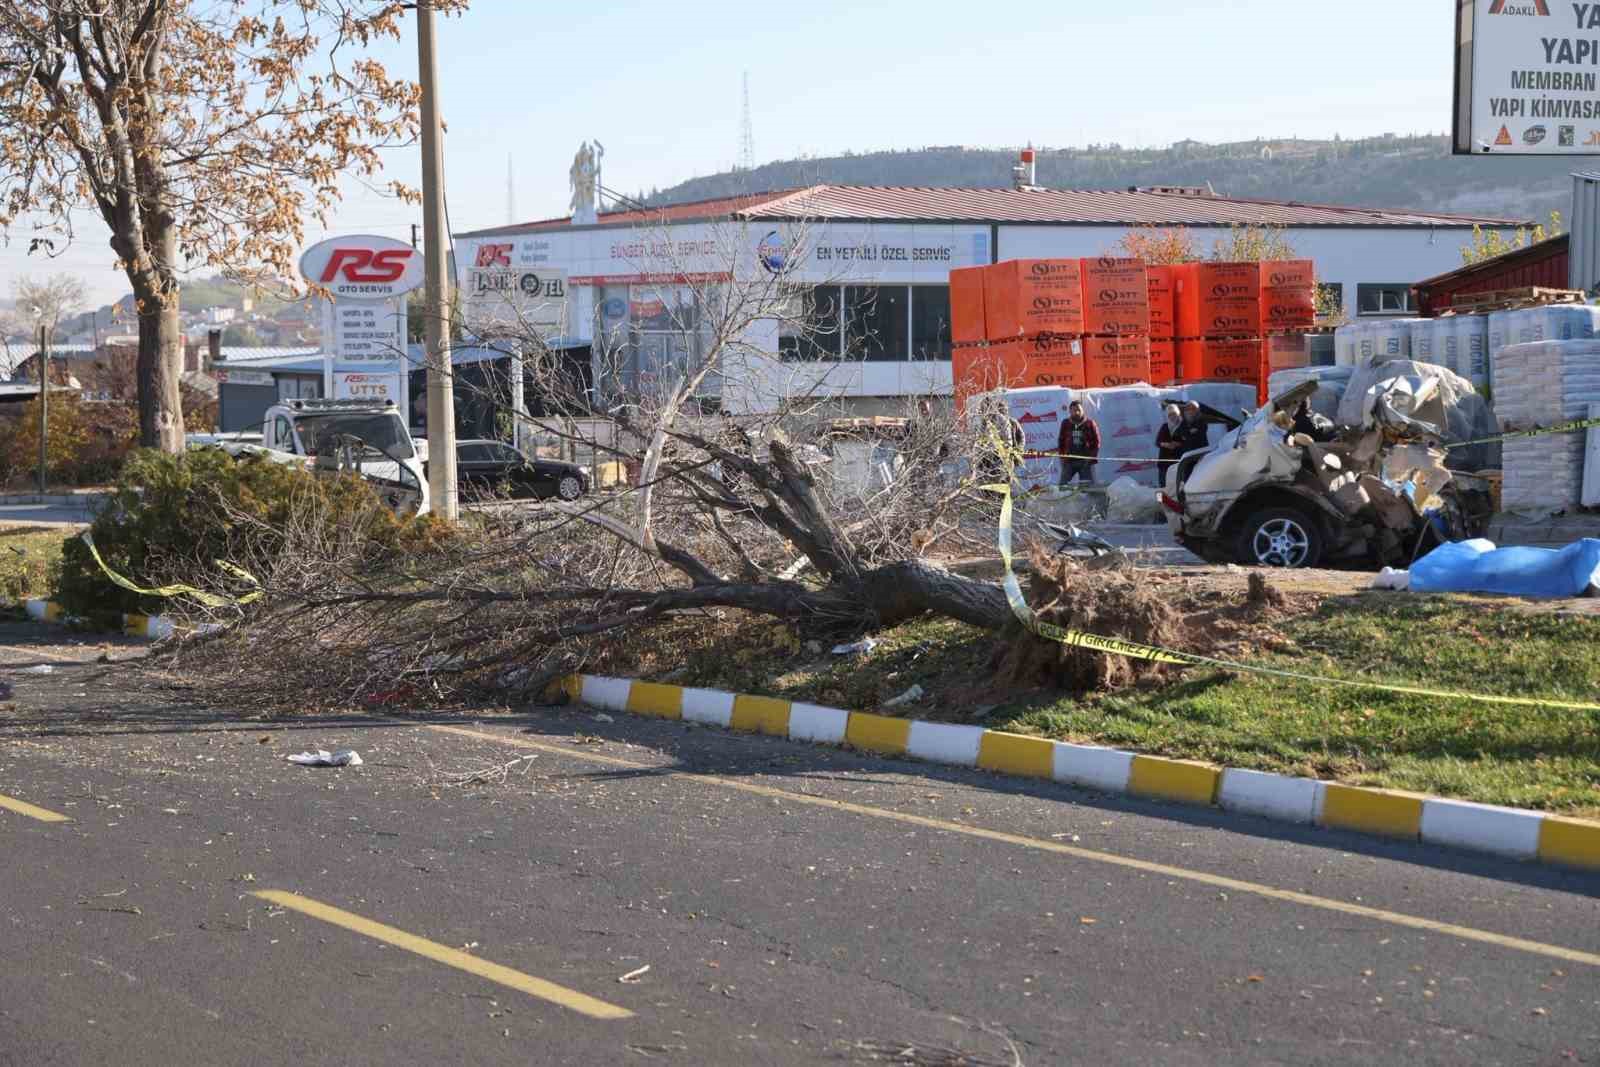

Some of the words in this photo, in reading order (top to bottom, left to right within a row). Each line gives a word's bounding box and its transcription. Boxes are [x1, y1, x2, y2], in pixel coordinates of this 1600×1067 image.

[1541, 38, 1598, 65] YAPI
[1511, 70, 1596, 91] MEMBRAN
[1490, 97, 1525, 117] YAPI
[1531, 93, 1600, 119] KİMYASA
[816, 247, 832, 260] EN
[881, 244, 909, 260] ÖZEL
[320, 249, 413, 283] RS
[338, 285, 358, 293] OTO
[349, 385, 388, 396] UTTS
